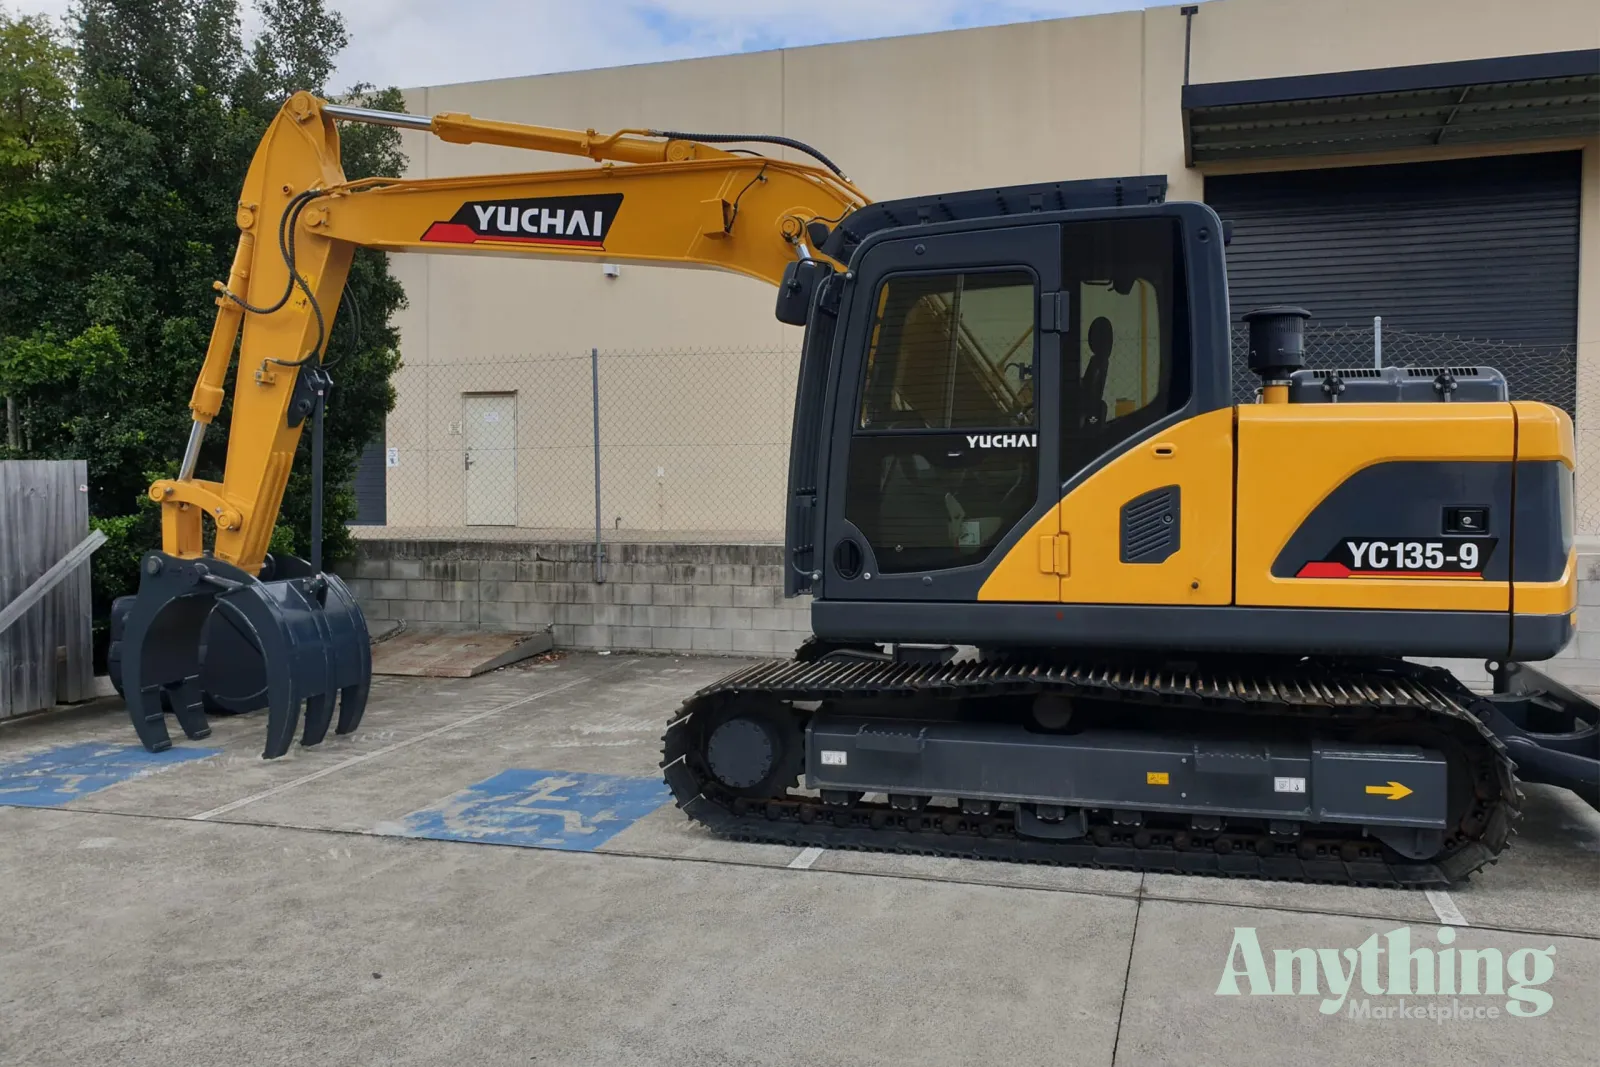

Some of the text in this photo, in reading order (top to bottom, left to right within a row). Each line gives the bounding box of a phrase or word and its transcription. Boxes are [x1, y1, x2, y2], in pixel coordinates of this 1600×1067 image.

[473, 205, 603, 237] YUCHAI
[966, 434, 1037, 448] YUCHAI
[1347, 541, 1479, 569] YC135-9
